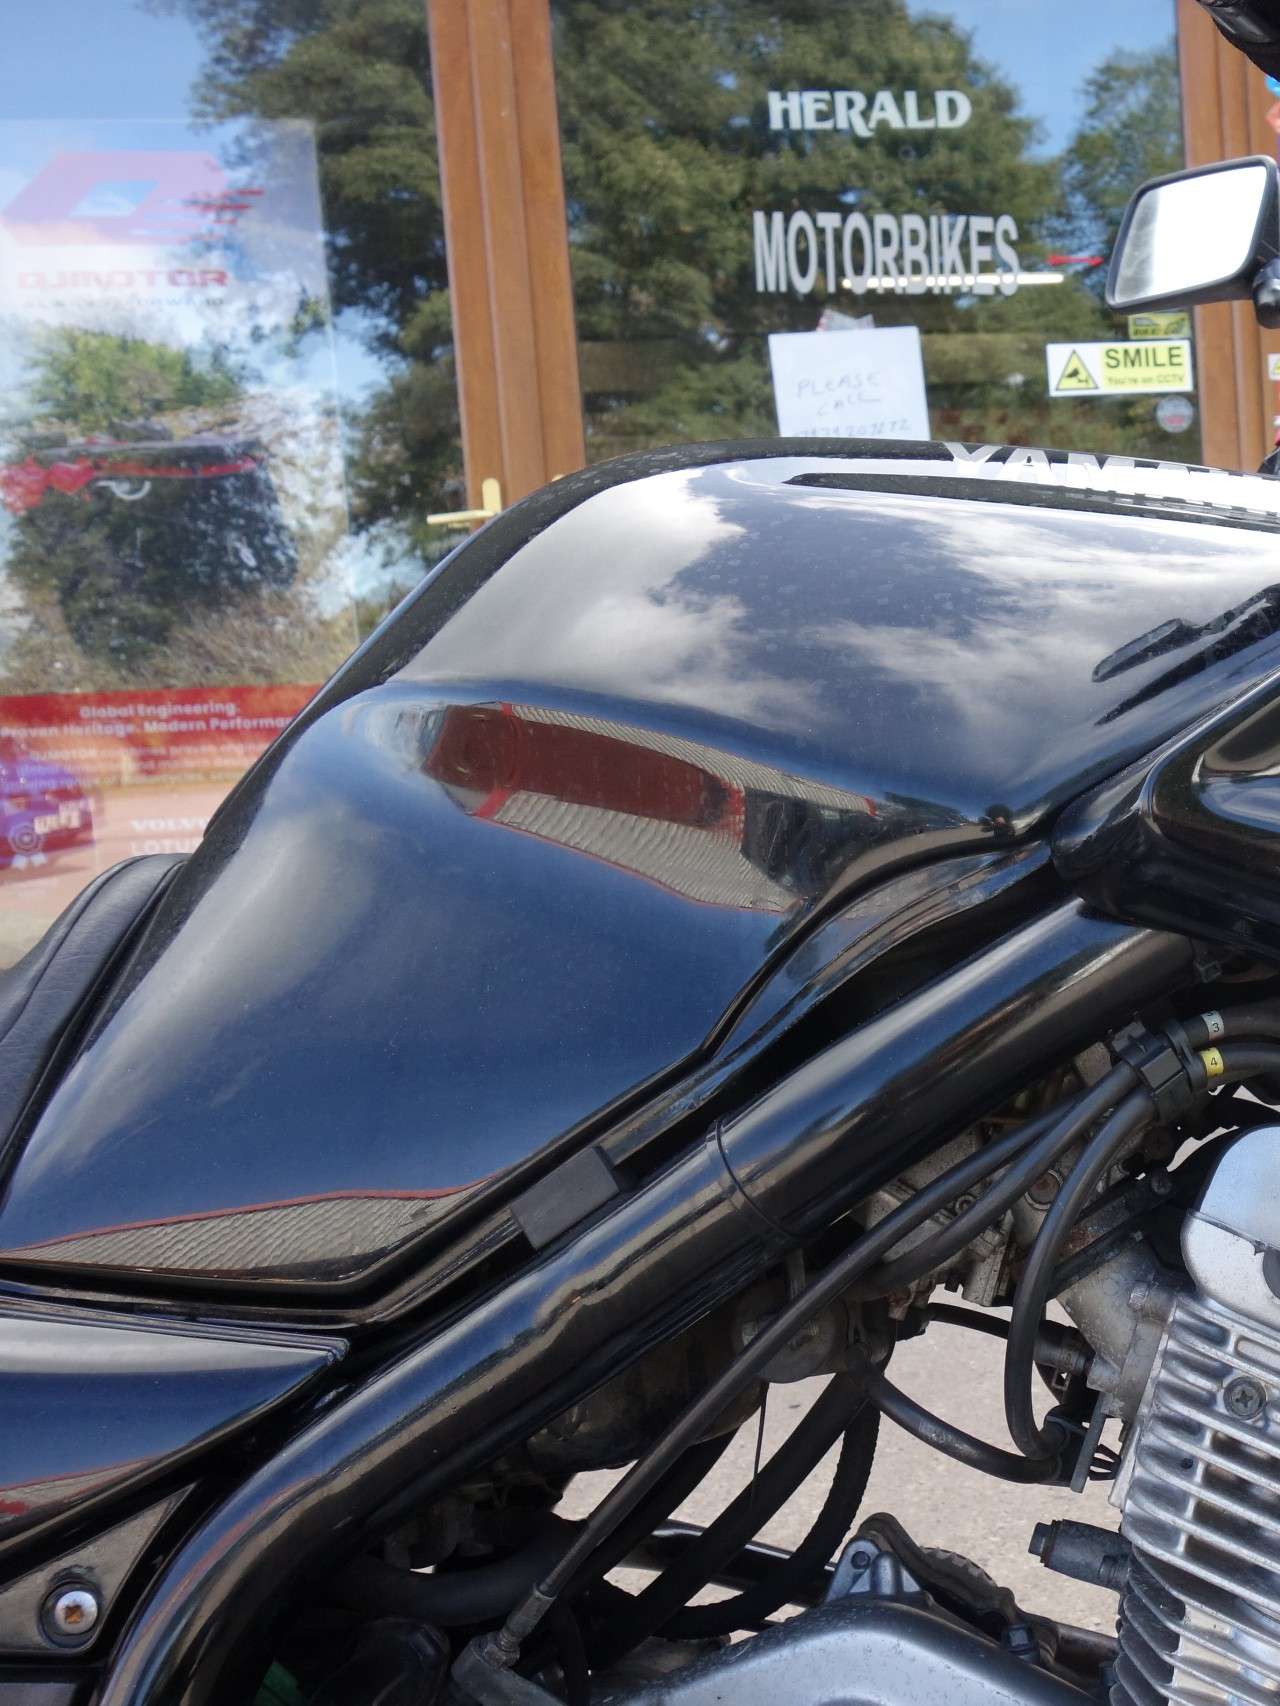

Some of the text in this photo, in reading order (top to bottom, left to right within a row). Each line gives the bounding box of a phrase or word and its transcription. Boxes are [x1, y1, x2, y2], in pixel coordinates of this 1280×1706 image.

[767, 89, 973, 138] HERALD
[752, 209, 1021, 296] MOTORBIKES
[1105, 346, 1184, 369] SMILE
[797, 371, 881, 399] PLEASE
[1157, 374, 1184, 384] CCTV
[817, 391, 881, 416] CALL
[80, 704, 134, 718] Global
[144, 719, 207, 733] Modern
[130, 816, 207, 832] VOLV
[1212, 1022, 1220, 1032] 3
[1210, 1057, 1217, 1065] 4
